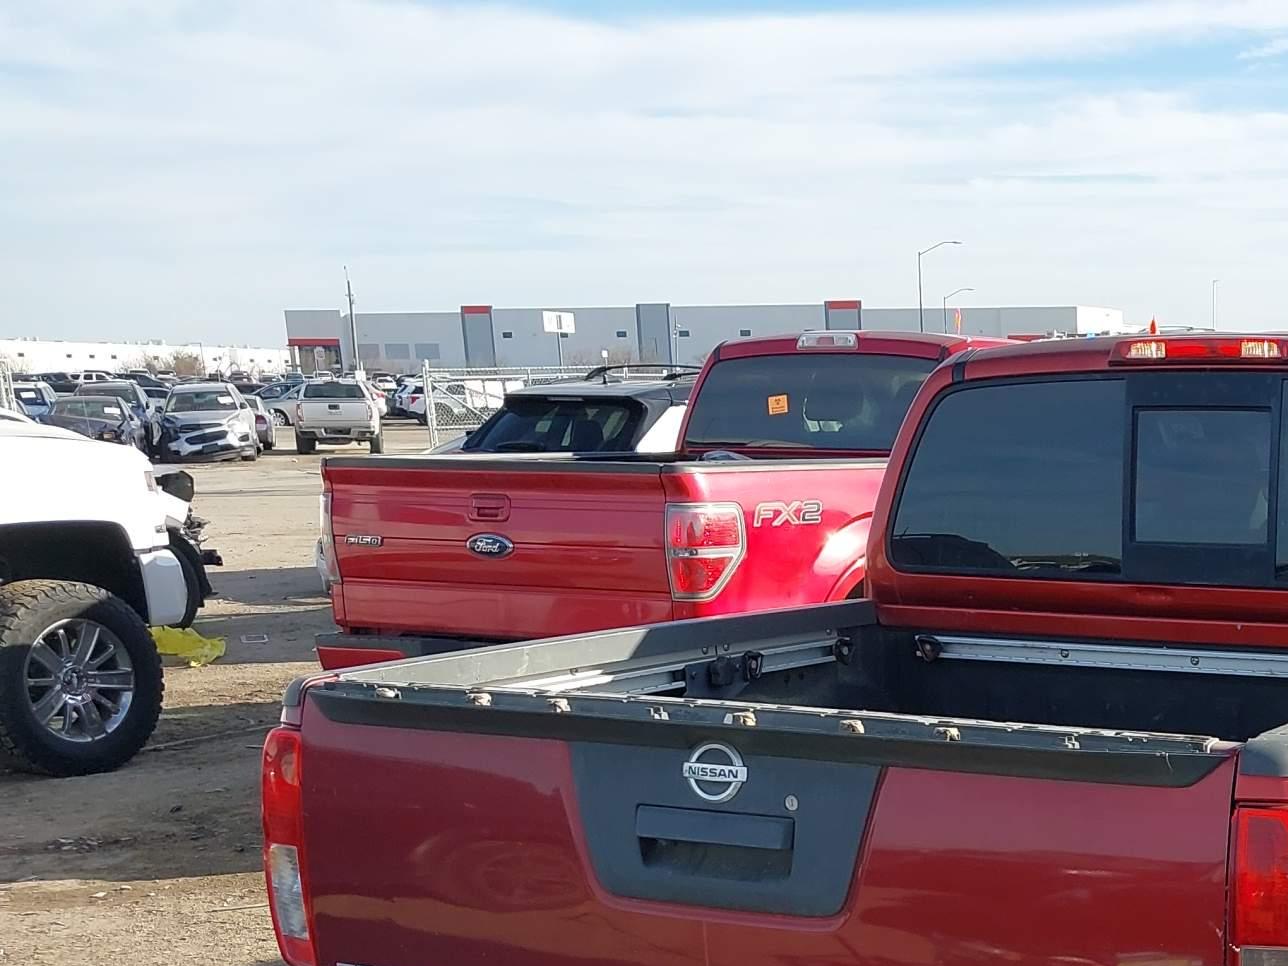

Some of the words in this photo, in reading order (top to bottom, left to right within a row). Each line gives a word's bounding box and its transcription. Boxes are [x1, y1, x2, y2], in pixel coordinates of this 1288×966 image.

[753, 500, 823, 528] FX2
[475, 538, 500, 552] Ford
[688, 765, 739, 779] NISSAN
